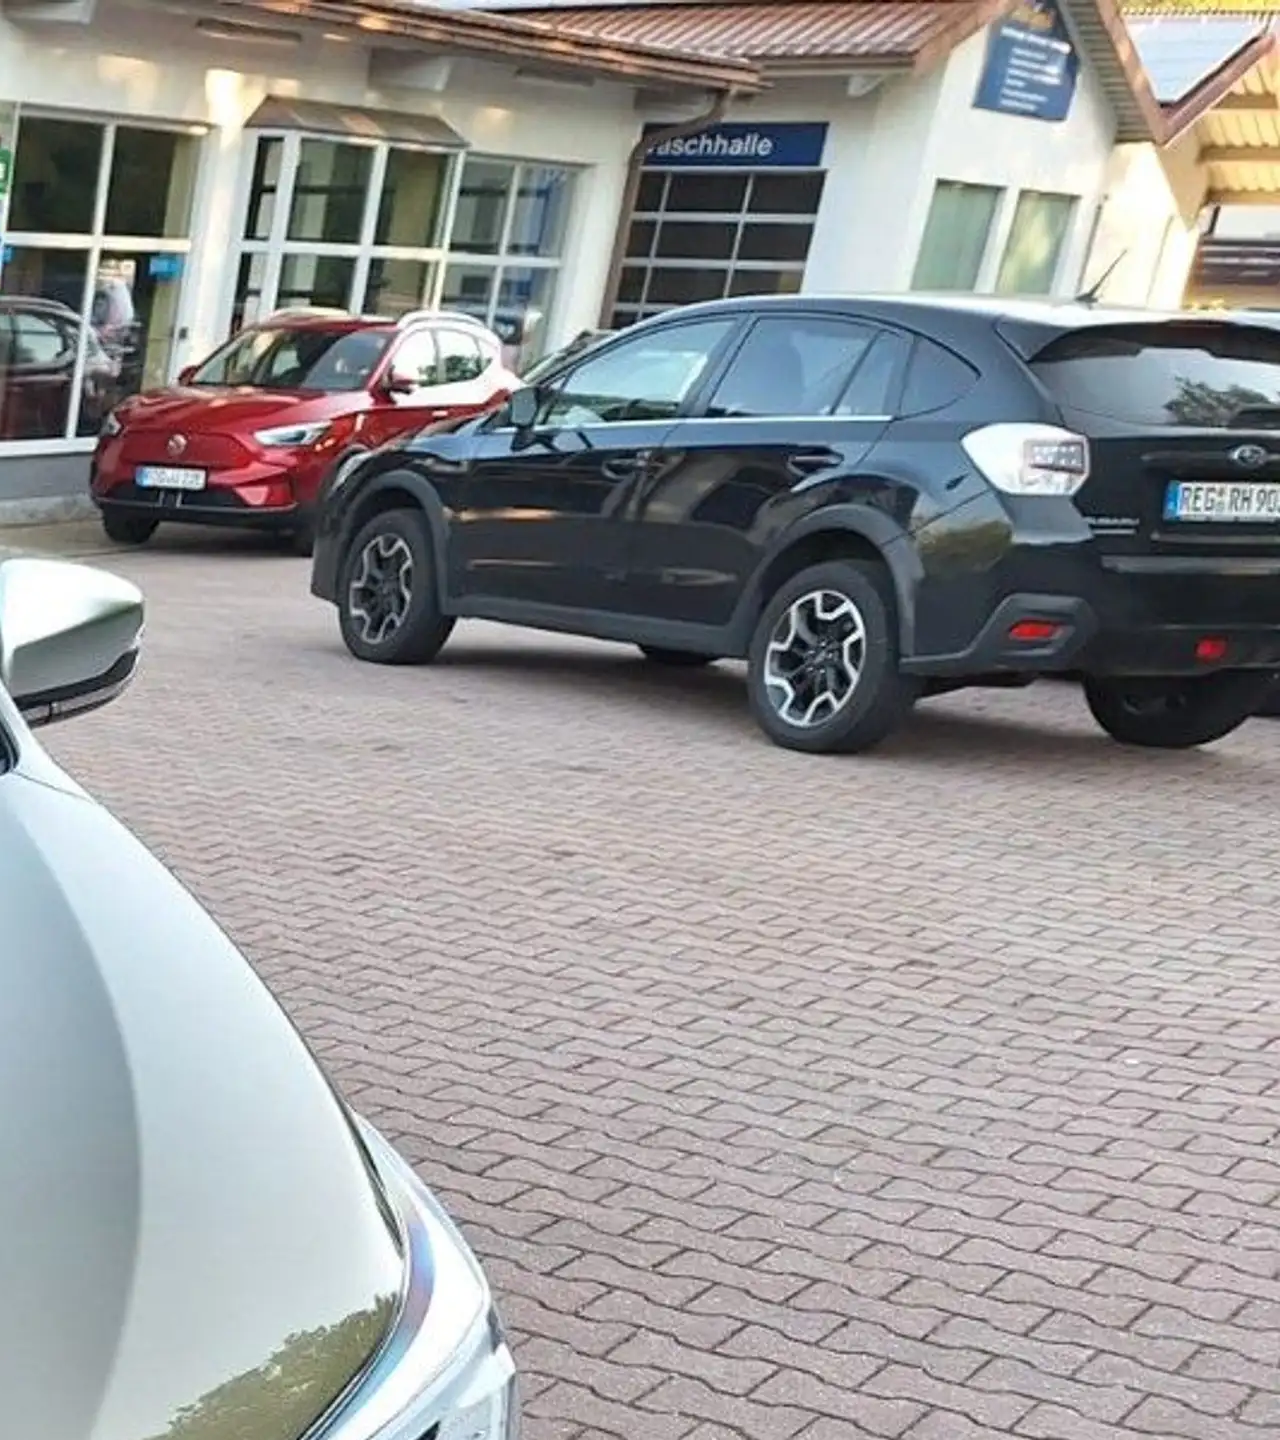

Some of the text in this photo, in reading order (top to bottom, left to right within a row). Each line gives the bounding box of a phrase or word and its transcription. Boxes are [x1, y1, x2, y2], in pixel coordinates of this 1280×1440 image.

[646, 132, 773, 156] aschhalle
[1180, 486, 1280, 513] REG RH 90
